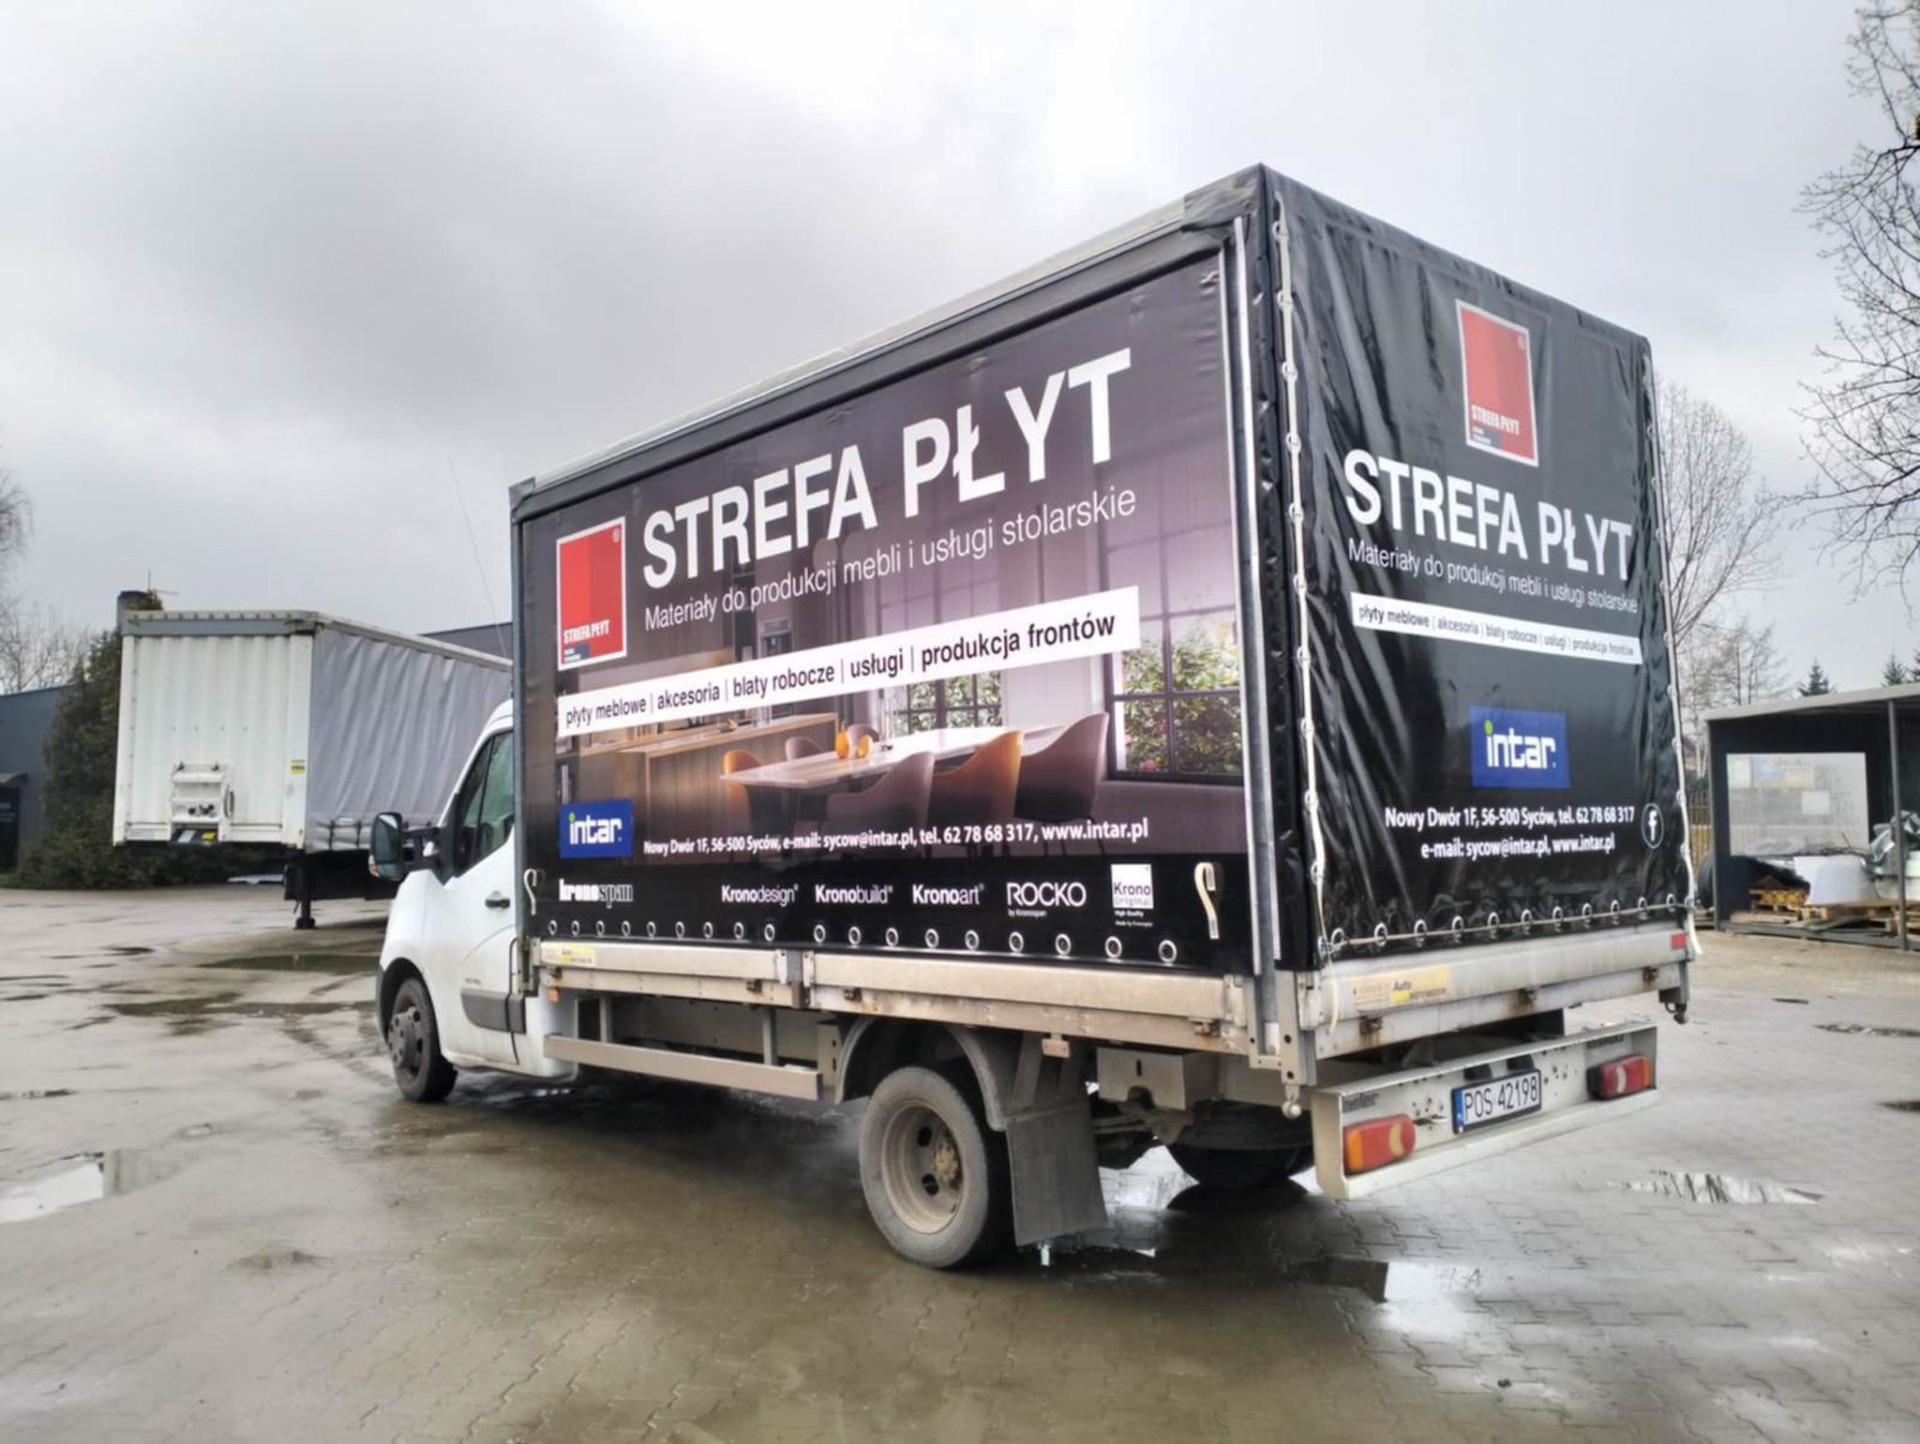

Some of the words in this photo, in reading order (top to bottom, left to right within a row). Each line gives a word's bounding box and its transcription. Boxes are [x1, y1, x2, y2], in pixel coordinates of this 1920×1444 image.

[643, 444, 878, 589] STREFA
[903, 347, 1131, 518] PŁYT
[1344, 449, 1528, 560] STREFA
[1538, 501, 1632, 581] PŁYT
[645, 596, 718, 631] Materiały
[722, 587, 745, 613] do
[750, 567, 837, 611] produkcji
[843, 543, 900, 584] mebli
[908, 540, 914, 569] i
[922, 519, 994, 566] usługi
[1002, 485, 1136, 546] stolarskie
[1349, 537, 1420, 578] Materiały
[1424, 554, 1444, 577] do
[1447, 562, 1505, 594] produkcji
[1508, 574, 1542, 596] mebli
[1544, 577, 1549, 598] i
[1551, 582, 1585, 608] usługi
[1587, 588, 1638, 613] stolarskie
[1359, 604, 1385, 624] płyty
[1387, 609, 1430, 628] meblowe
[566, 706, 592, 728] płyty
[596, 698, 647, 720] meblowe
[657, 683, 720, 710] akcesoria
[733, 675, 770, 704] blaty
[772, 664, 835, 692] robocze
[850, 647, 903, 678] usługi
[921, 629, 1020, 672] produkcja
[1028, 612, 1116, 649] frontów
[1484, 720, 1556, 769] intar
[568, 812, 622, 845] intar
[643, 840, 669, 857] Nowy
[670, 838, 695, 854] Dwór
[711, 836, 745, 852] 56-500
[747, 834, 781, 854] Syców,
[783, 832, 821, 849] e-mail:
[823, 827, 917, 852] sycow@intar.pl,
[919, 826, 941, 845] tel.
[943, 826, 961, 844] 62
[964, 825, 982, 843] 78
[984, 824, 1003, 842] 68
[1006, 823, 1038, 843] 317,
[1041, 817, 1149, 843] www.intar.pl
[1385, 807, 1425, 832] Nowy
[1427, 806, 1461, 827] Dwór
[1463, 807, 1479, 829] 1F,
[1481, 807, 1520, 826] 56-500
[1521, 806, 1557, 830] Syców,
[1558, 806, 1575, 824] tel.
[1576, 807, 1589, 824] 62
[1590, 807, 1603, 823] 78
[1604, 806, 1617, 823] 68
[1618, 806, 1635, 823] 317
[1421, 836, 1464, 858] e-mail:
[1552, 832, 1615, 854] www.intar.pl
[1006, 881, 1087, 907] ROCKO
[1113, 882, 1152, 896] Krono
[1464, 1087, 1493, 1121] POS
[1497, 1076, 1538, 1110] 42198
